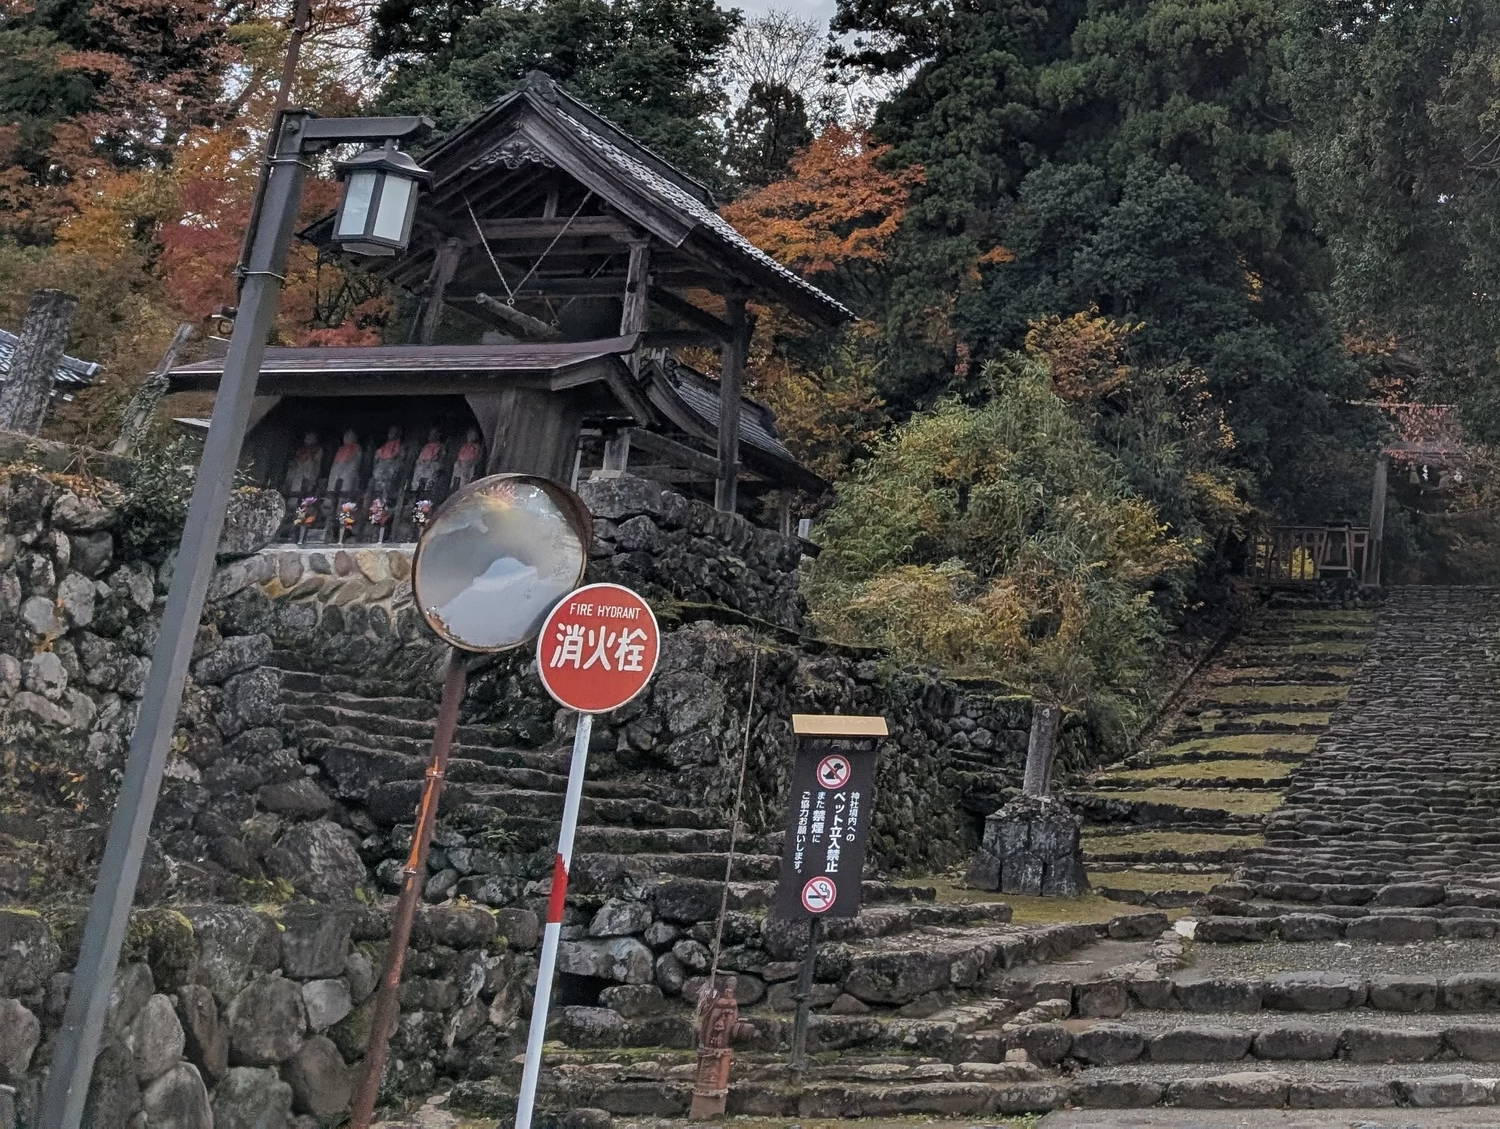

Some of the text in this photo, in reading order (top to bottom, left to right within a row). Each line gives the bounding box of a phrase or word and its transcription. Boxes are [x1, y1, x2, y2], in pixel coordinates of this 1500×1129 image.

[569, 603, 641, 620] FIRE HYDRANT
[550, 622, 648, 672] 消火栓
[794, 791, 811, 874] ご協力お願いします。
[811, 791, 826, 843] また禁煙に
[824, 791, 846, 873] ペット立入禁止
[846, 791, 860, 842] 神社境内への
